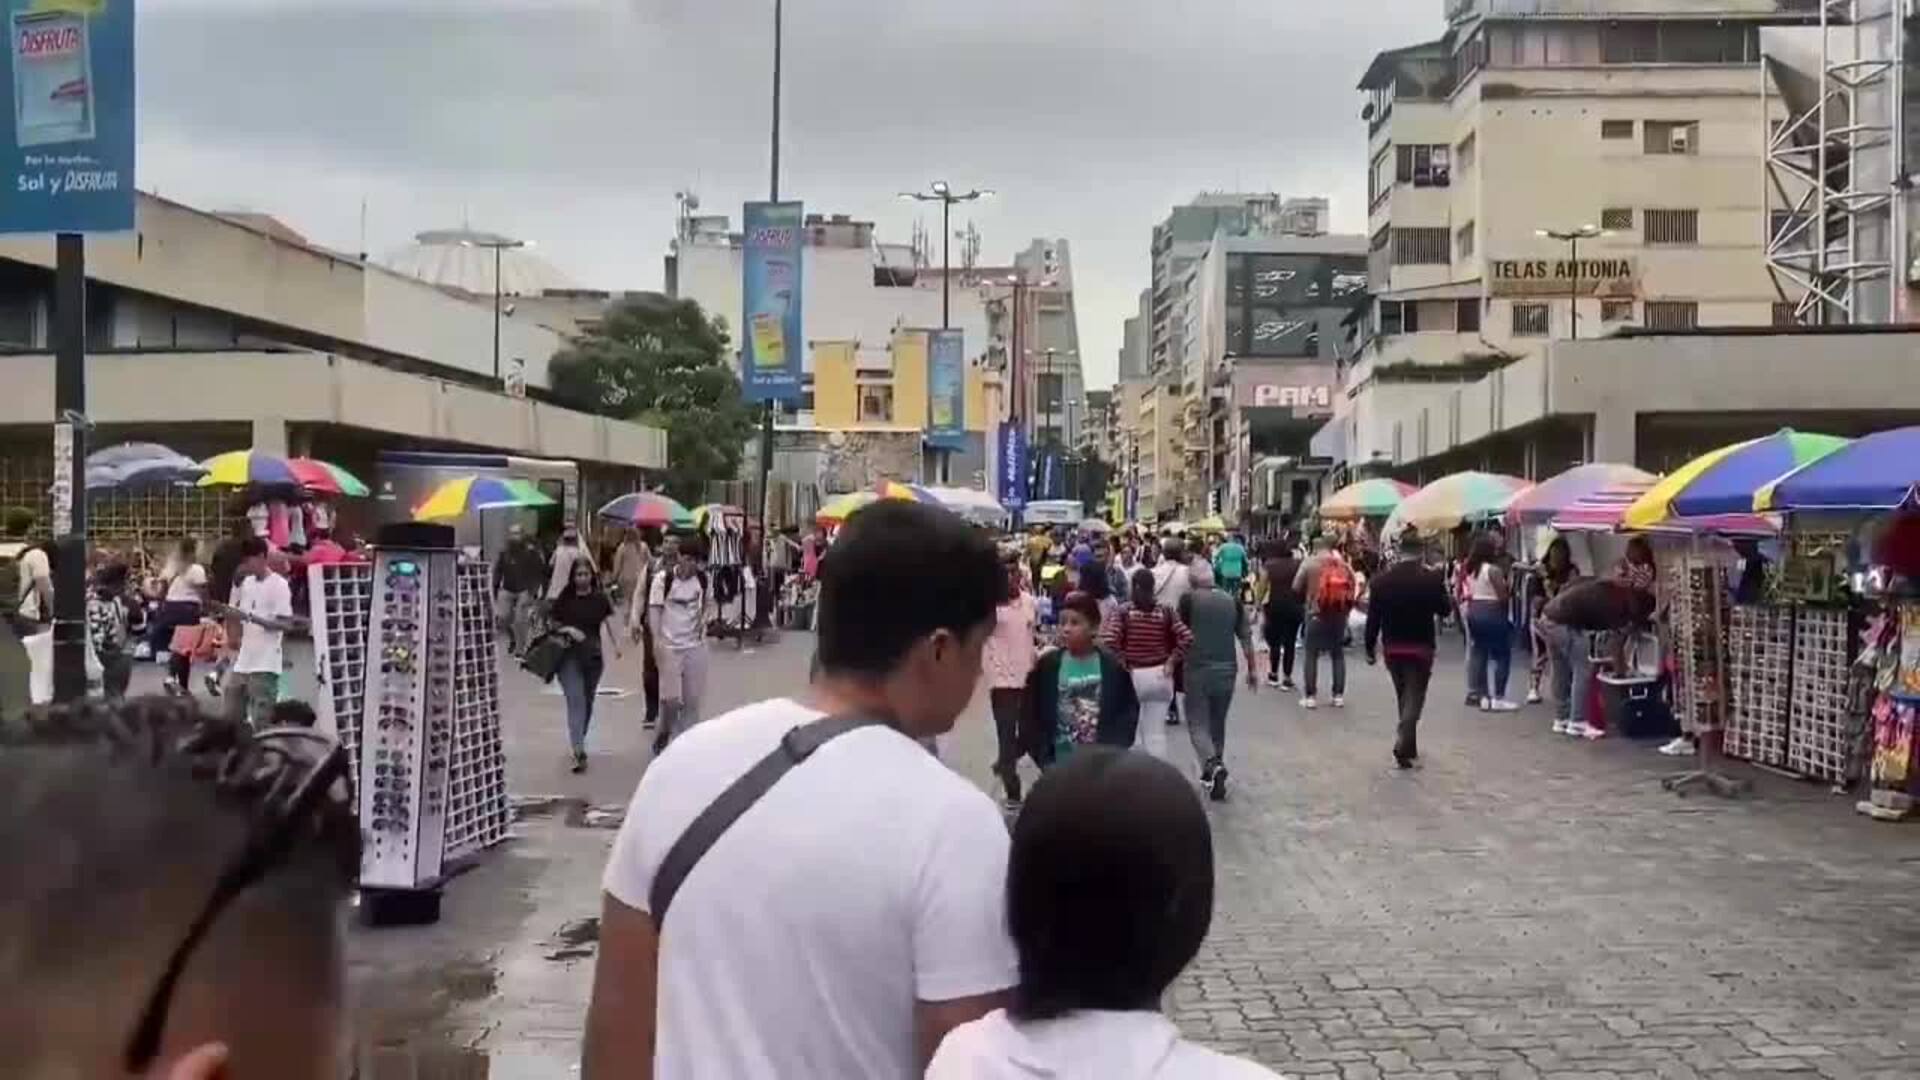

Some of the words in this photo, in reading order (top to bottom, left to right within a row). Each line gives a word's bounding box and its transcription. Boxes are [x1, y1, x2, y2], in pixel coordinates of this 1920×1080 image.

[17, 172, 44, 192] Sol
[49, 178, 61, 196] y
[1493, 260, 1547, 279] TELAS
[1555, 260, 1631, 279] ANTONIA
[1254, 384, 1329, 407] PAM
